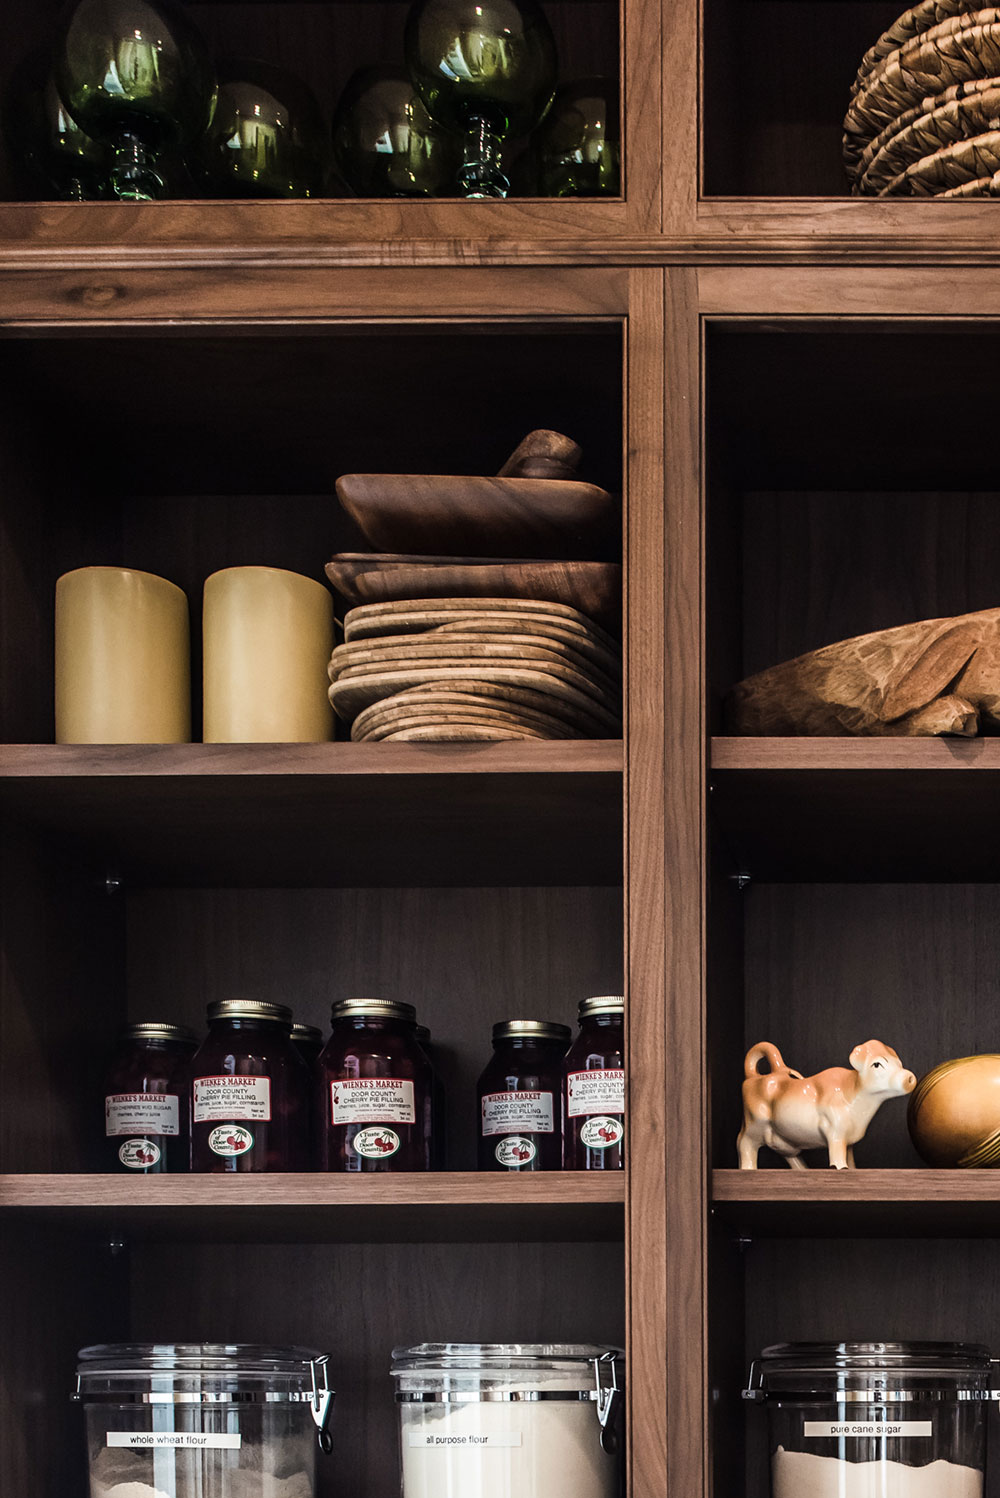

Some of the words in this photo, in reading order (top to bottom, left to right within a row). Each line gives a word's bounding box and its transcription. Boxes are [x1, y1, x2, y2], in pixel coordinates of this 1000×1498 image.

[342, 1081, 374, 1089] WIENKE'S
[488, 1094, 512, 1102] WIENKE'S
[830, 1426, 850, 1434] pure
[876, 1426, 902, 1434] sugar
[130, 1436, 154, 1444] whole
[157, 1436, 184, 1444] wheat
[186, 1436, 207, 1444] flour
